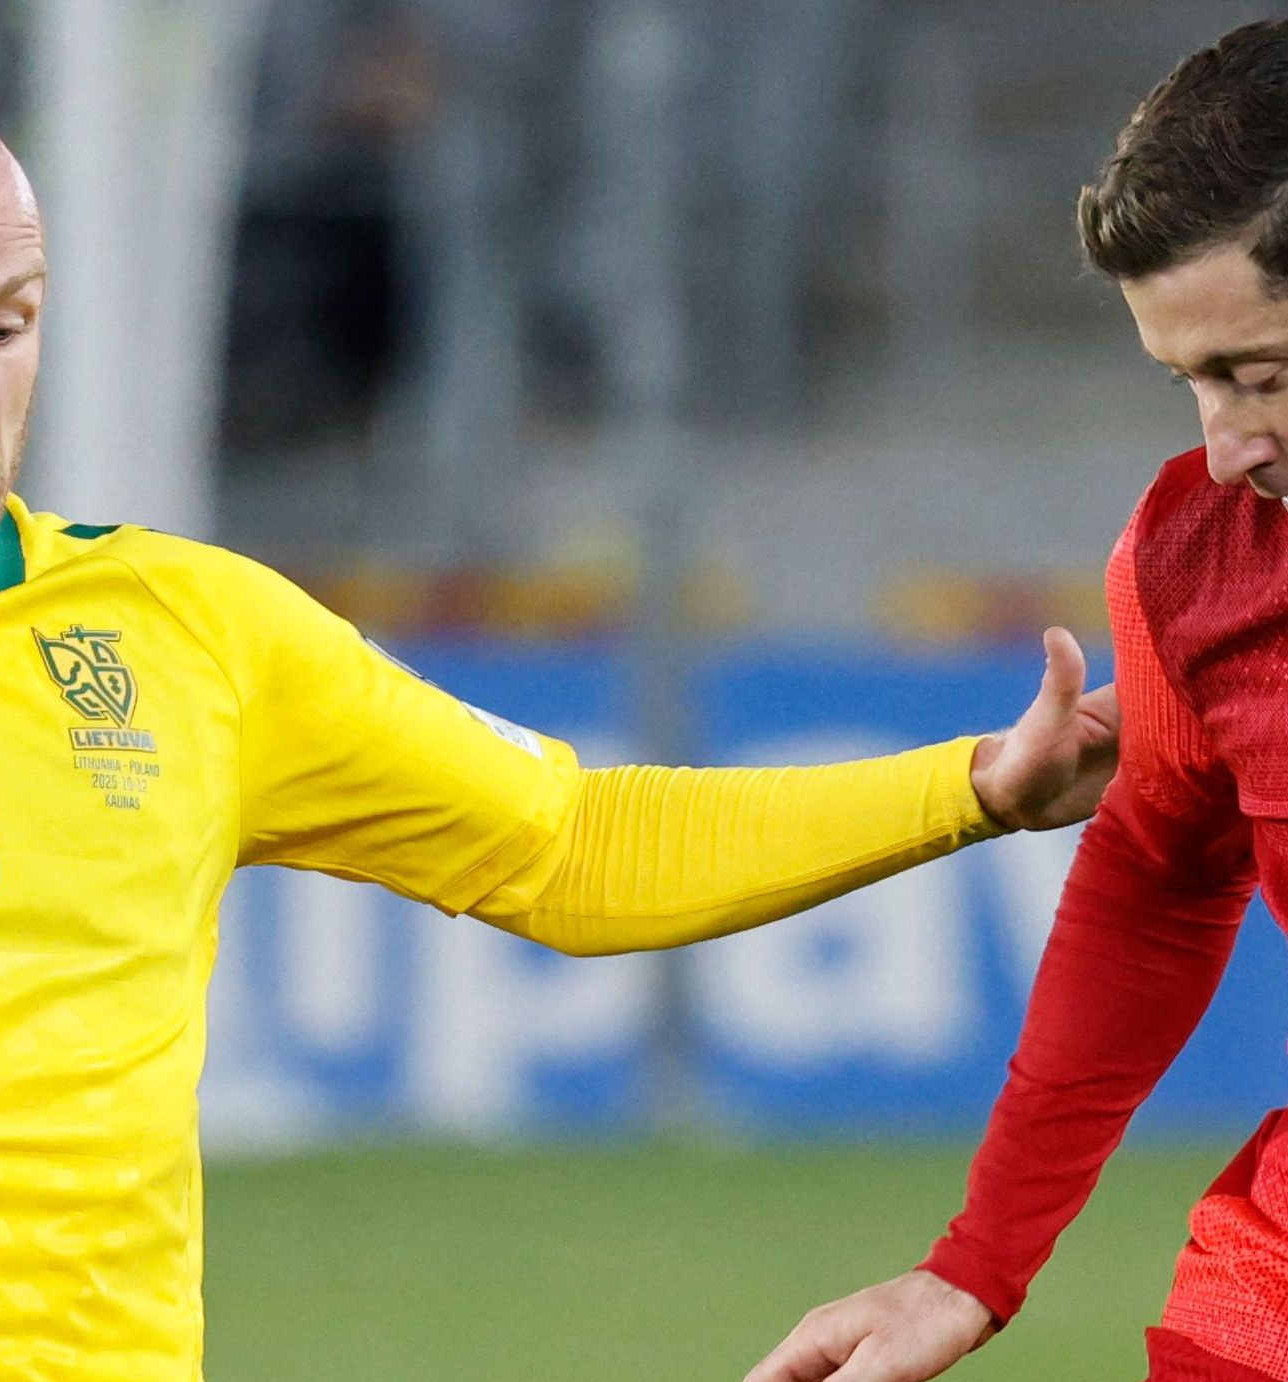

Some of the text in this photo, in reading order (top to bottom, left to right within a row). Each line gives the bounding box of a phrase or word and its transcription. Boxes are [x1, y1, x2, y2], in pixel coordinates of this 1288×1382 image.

[74, 730, 153, 748] LIETUVA
[74, 755, 121, 770] LITHUANIA
[130, 760, 160, 777] POLAND
[105, 793, 140, 810] KAUNAS
